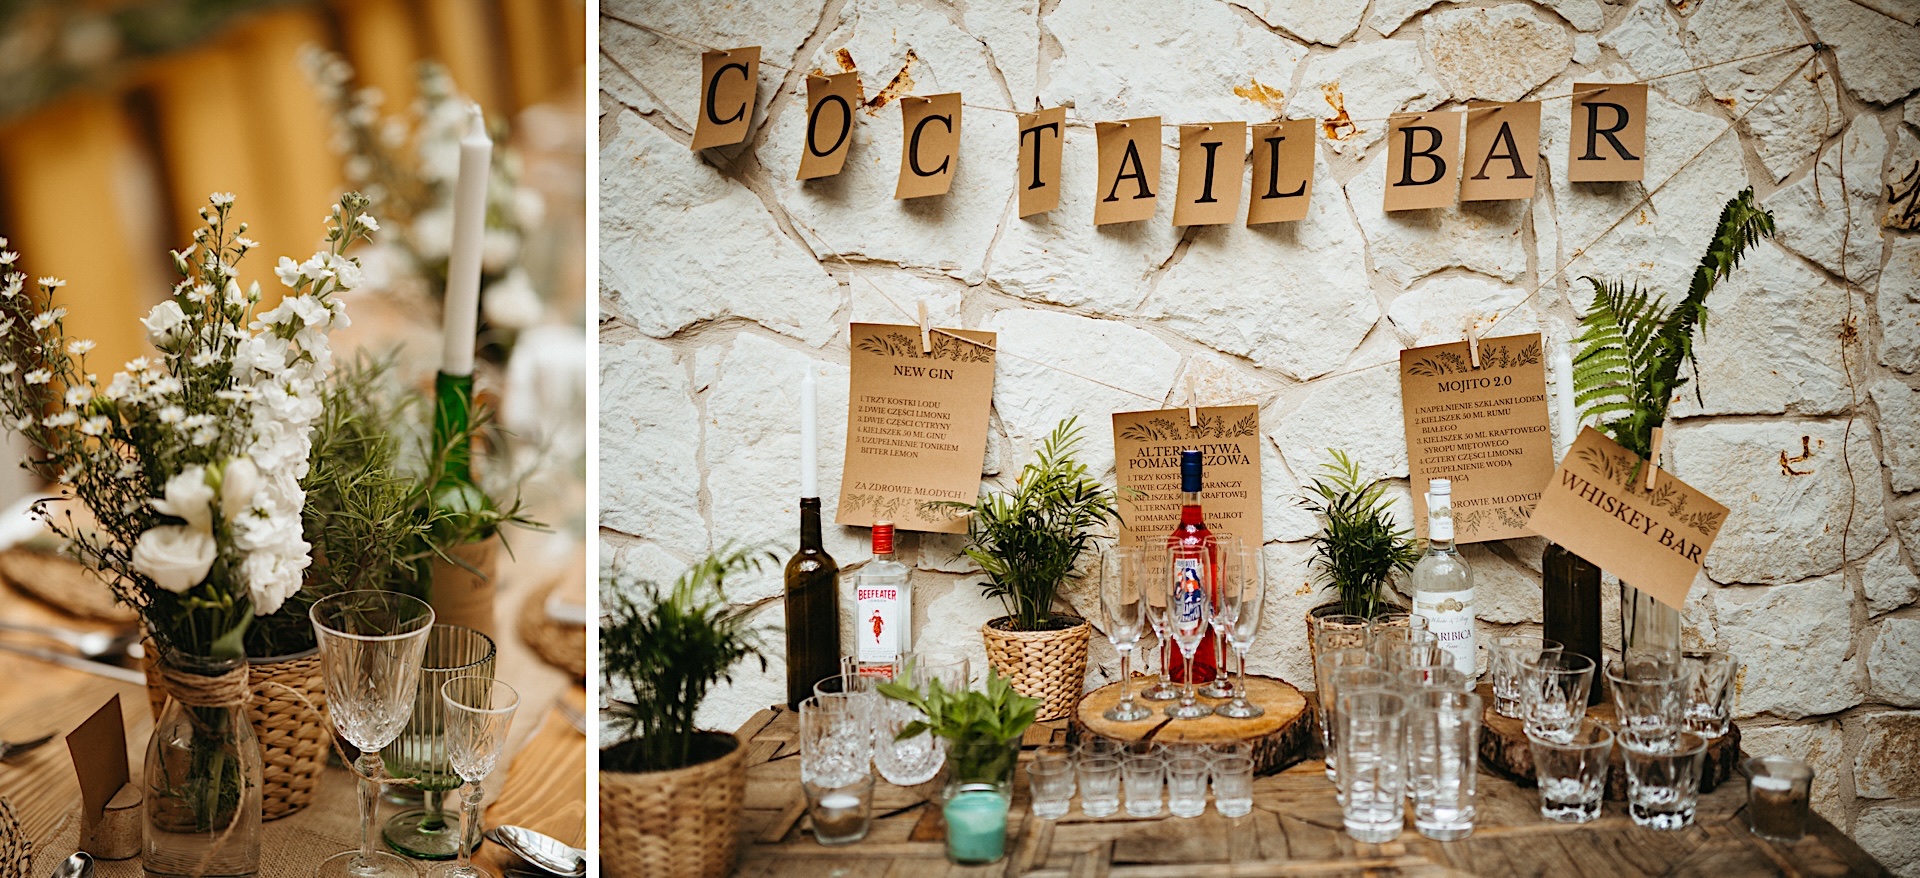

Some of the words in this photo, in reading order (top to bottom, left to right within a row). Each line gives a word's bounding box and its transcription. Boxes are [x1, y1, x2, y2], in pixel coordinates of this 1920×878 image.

[706, 62, 1307, 204] COCTAIL
[1393, 102, 1640, 187] BAR
[894, 365, 926, 378] NEW
[928, 368, 954, 380] GIN
[1438, 377, 1490, 394] MOJITO
[1494, 376, 1512, 387] 2.0
[865, 395, 886, 404] TRZY
[887, 398, 916, 406] KOSTKI
[918, 400, 940, 409] LODU
[1474, 398, 1513, 408] SZKLANKI
[1514, 394, 1544, 404] LODEM
[864, 406, 886, 414] DWIE
[886, 407, 914, 417] CZĘŚCI
[916, 410, 951, 420] LIMONKI
[1421, 414, 1461, 424] KIELISZEK
[1462, 412, 1472, 420] 50
[1472, 410, 1486, 418] ML
[1487, 408, 1511, 417] RUMU
[864, 416, 885, 424] DWIE
[886, 418, 914, 427] CZĘŚCI
[914, 420, 952, 430] CYTRYNY
[1422, 424, 1458, 434] BIAŁEGO
[862, 426, 902, 436] KIELISZEK
[902, 430, 912, 438] 50
[926, 432, 946, 440] GINU
[1423, 434, 1463, 444] KIELISZEK
[1464, 432, 1474, 440] 50
[1475, 430, 1488, 438] ML
[1488, 425, 1546, 437] KRAFTOWEGO
[862, 436, 918, 448] UZUPEŁNIENIE
[920, 442, 959, 452] TONIKIEM
[1424, 444, 1456, 454] SYROPU
[1457, 440, 1509, 452] MIĘTOWEGO
[860, 446, 888, 456] BITTER
[890, 449, 918, 458] LEMON
[1425, 455, 1456, 464] CZTERY
[1458, 452, 1486, 462] CZĘŚCI
[1487, 448, 1523, 458] LIMONKI
[1129, 454, 1250, 469] POMARCZOWA
[1426, 462, 1485, 474] UZUPEŁNIENIE
[1486, 460, 1512, 468] WODĄ
[1156, 472, 1182, 480] KOSTK
[1428, 474, 1470, 484] JĄCĄ
[854, 482, 866, 490] ZA
[868, 482, 912, 494] ZDROWIE
[914, 487, 962, 499] MŁODYCH
[1156, 482, 1182, 492] CZĘŚC
[1202, 480, 1242, 489] ARAŃCZY
[1452, 498, 1490, 508] DROWIE
[1492, 492, 1542, 504] MŁODYCH
[1134, 504, 1182, 512] ALTERNATY
[1208, 512, 1244, 520] PALIKOT
[1562, 469, 1658, 536] WHISKEY
[1658, 528, 1702, 564] BAR
[1136, 524, 1175, 532] KIELISZEK
[858, 590, 896, 601] BEEFEATER
[1436, 629, 1472, 641] ARIBICA
